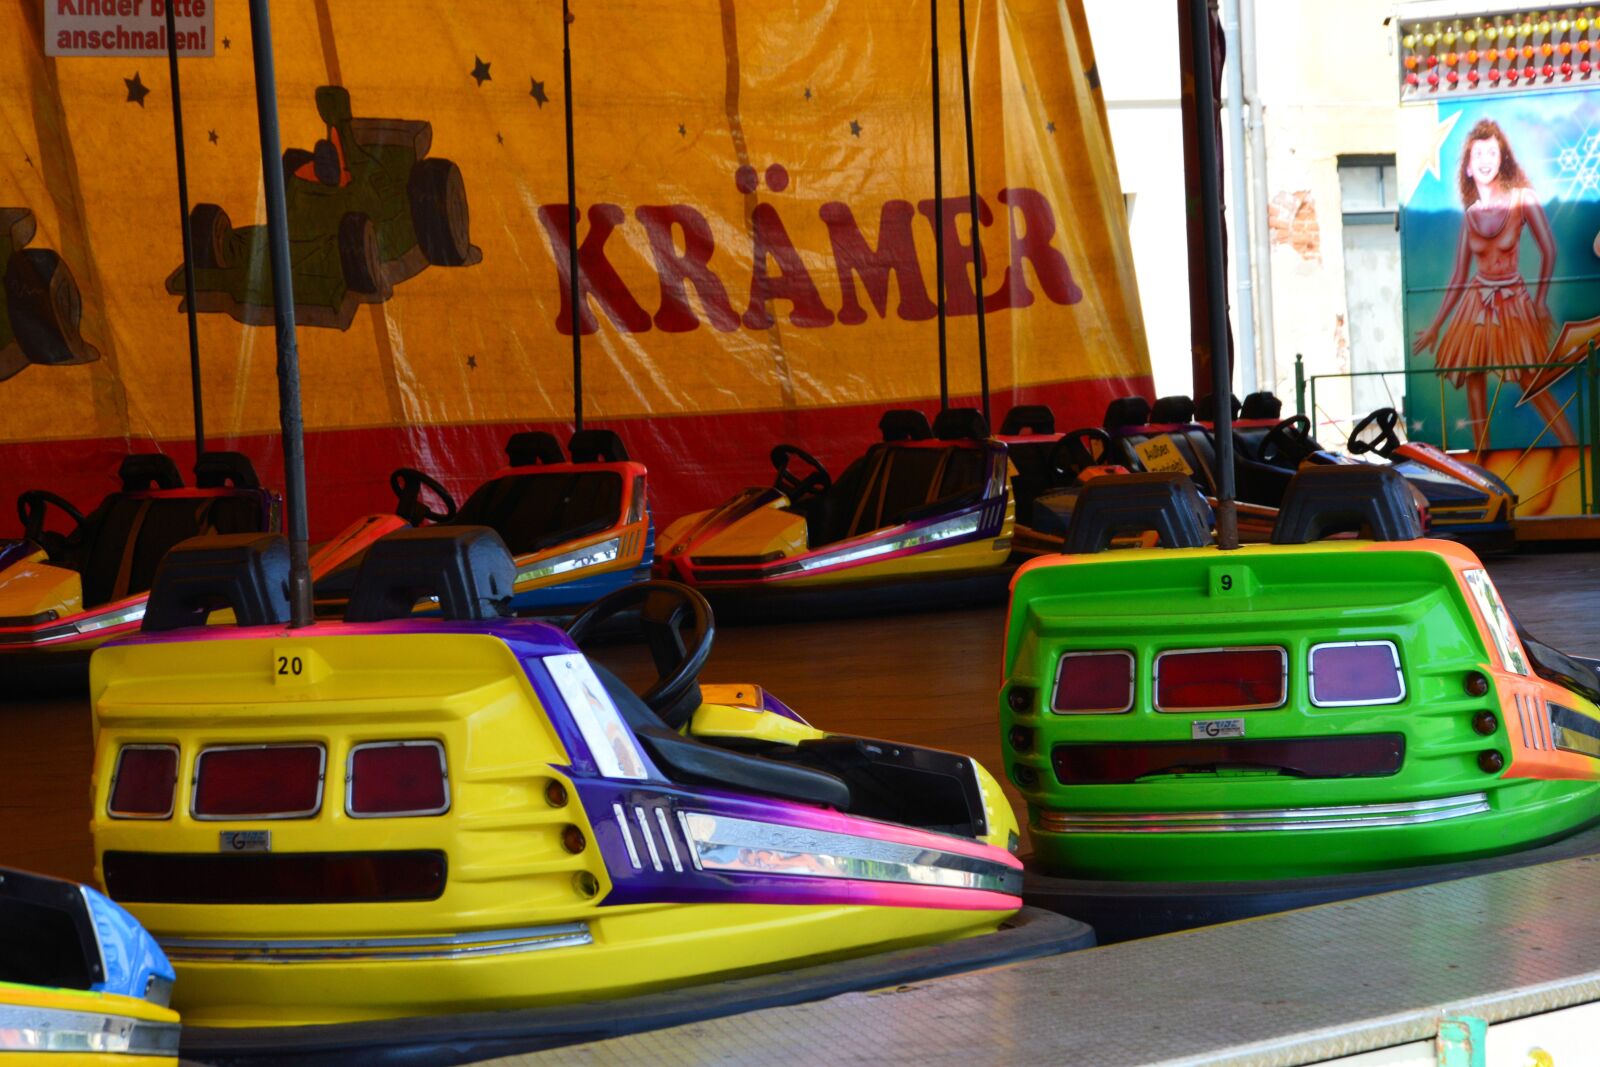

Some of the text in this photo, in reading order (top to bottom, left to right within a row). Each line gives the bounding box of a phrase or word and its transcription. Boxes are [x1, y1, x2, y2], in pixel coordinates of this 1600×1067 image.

[57, 0, 206, 17] Kinder btte
[57, 24, 206, 50] anschnalen!
[538, 163, 1082, 336] KRÄMER
[1221, 574, 1233, 591] 9
[278, 656, 303, 676] 20
